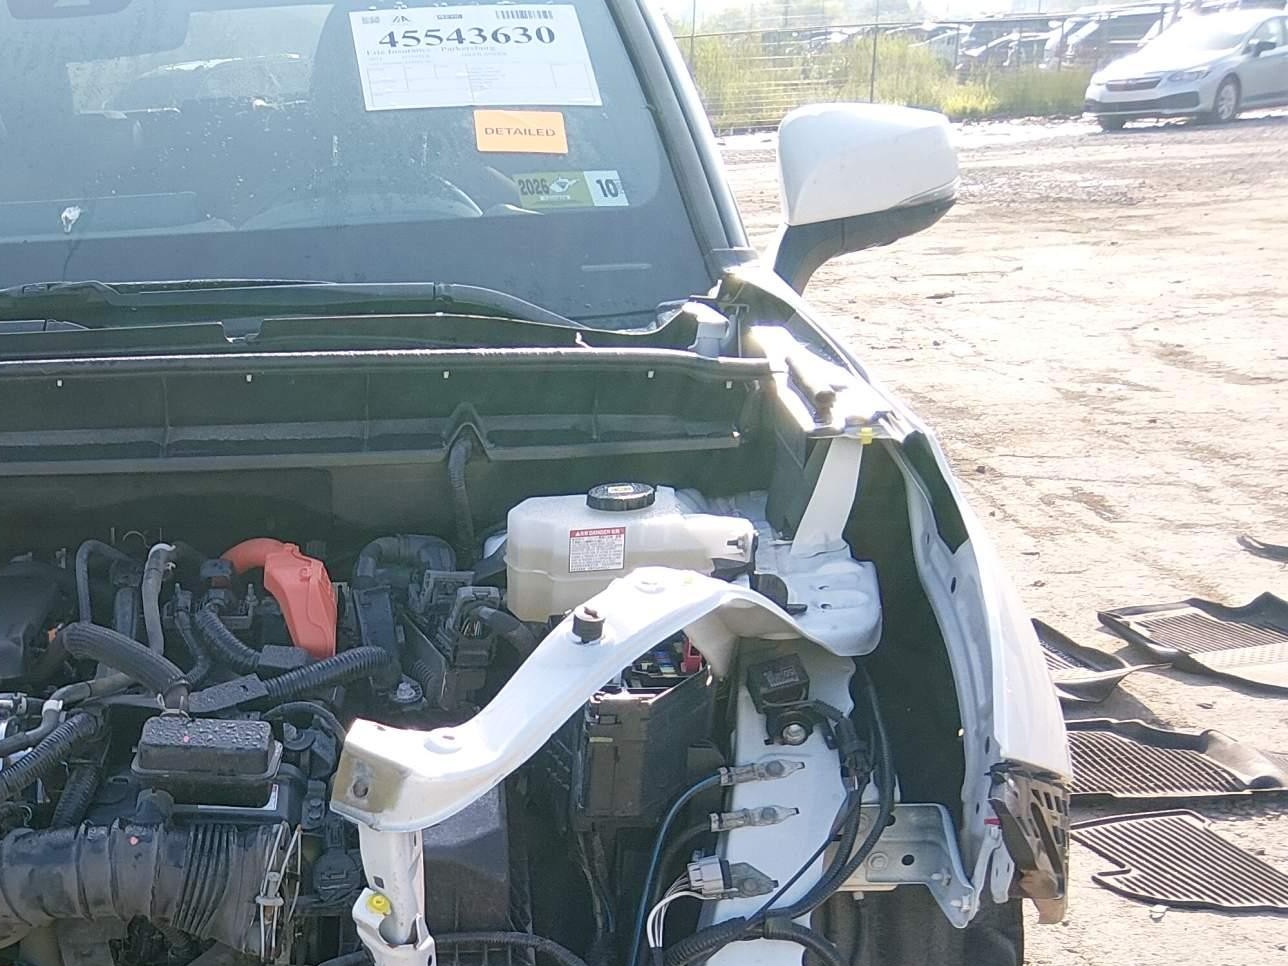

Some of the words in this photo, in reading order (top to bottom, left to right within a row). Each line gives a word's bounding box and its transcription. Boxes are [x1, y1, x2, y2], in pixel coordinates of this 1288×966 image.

[379, 26, 555, 48] 45543630
[484, 127, 556, 137] DETAILED
[518, 178, 550, 196] 2026
[596, 179, 619, 198] 10
